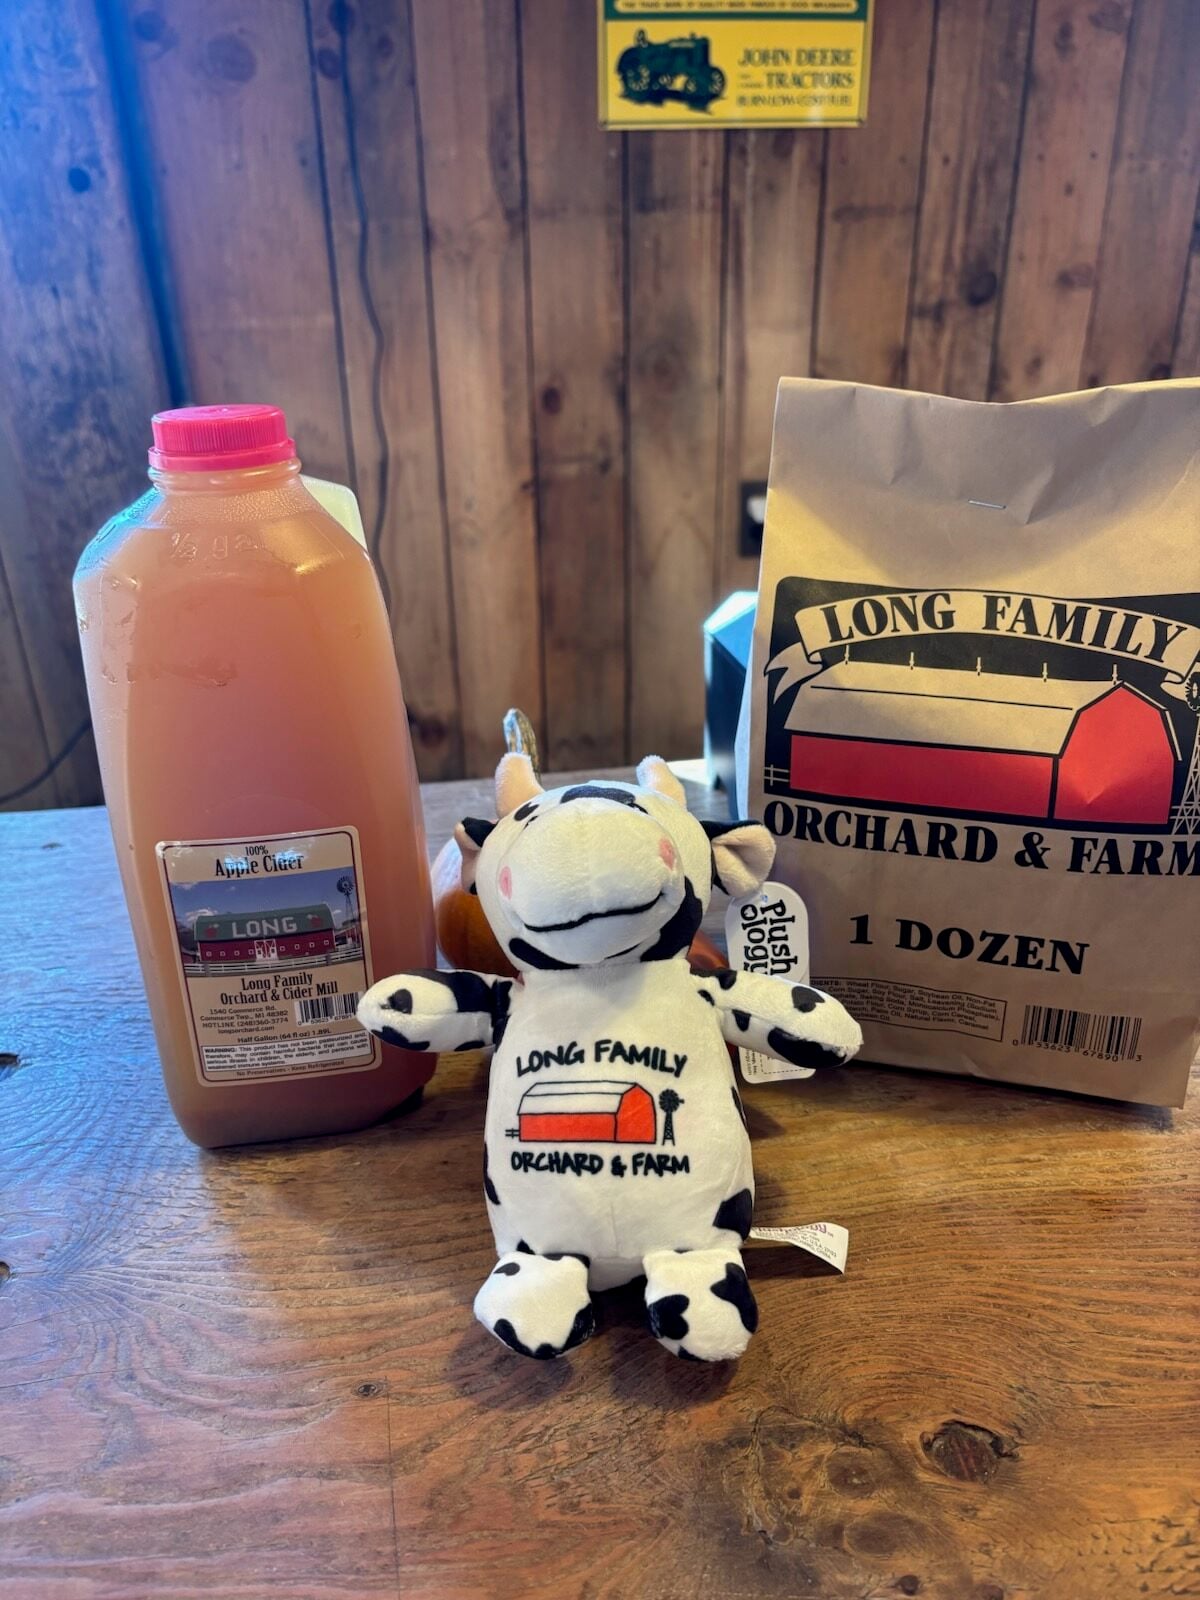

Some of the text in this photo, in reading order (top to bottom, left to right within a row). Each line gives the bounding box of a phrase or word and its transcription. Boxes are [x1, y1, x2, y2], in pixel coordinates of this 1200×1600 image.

[738, 48, 855, 67] JOHN DEERE
[766, 71, 855, 89] TRACTORS
[820, 591, 1189, 664] LONG FAMILY
[763, 800, 1200, 877] ORCHARD & FARM
[245, 845, 269, 857] 100%
[215, 852, 304, 878] Apple Cider
[232, 916, 298, 938] LONG
[760, 899, 798, 975] Plush
[849, 914, 1091, 975] 1 DOZEN
[241, 971, 314, 991] Long Family
[220, 981, 339, 1005] Orchard & Cider Mill
[228, 1006, 264, 1015] Commerce
[202, 1021, 236, 1029] HOTLINE
[254, 1034, 278, 1042] Gallon
[516, 1039, 688, 1078] LONG FAMILY
[1082, 1051, 1119, 1062] 67890
[510, 1151, 690, 1178] ORCHARD & FARM
